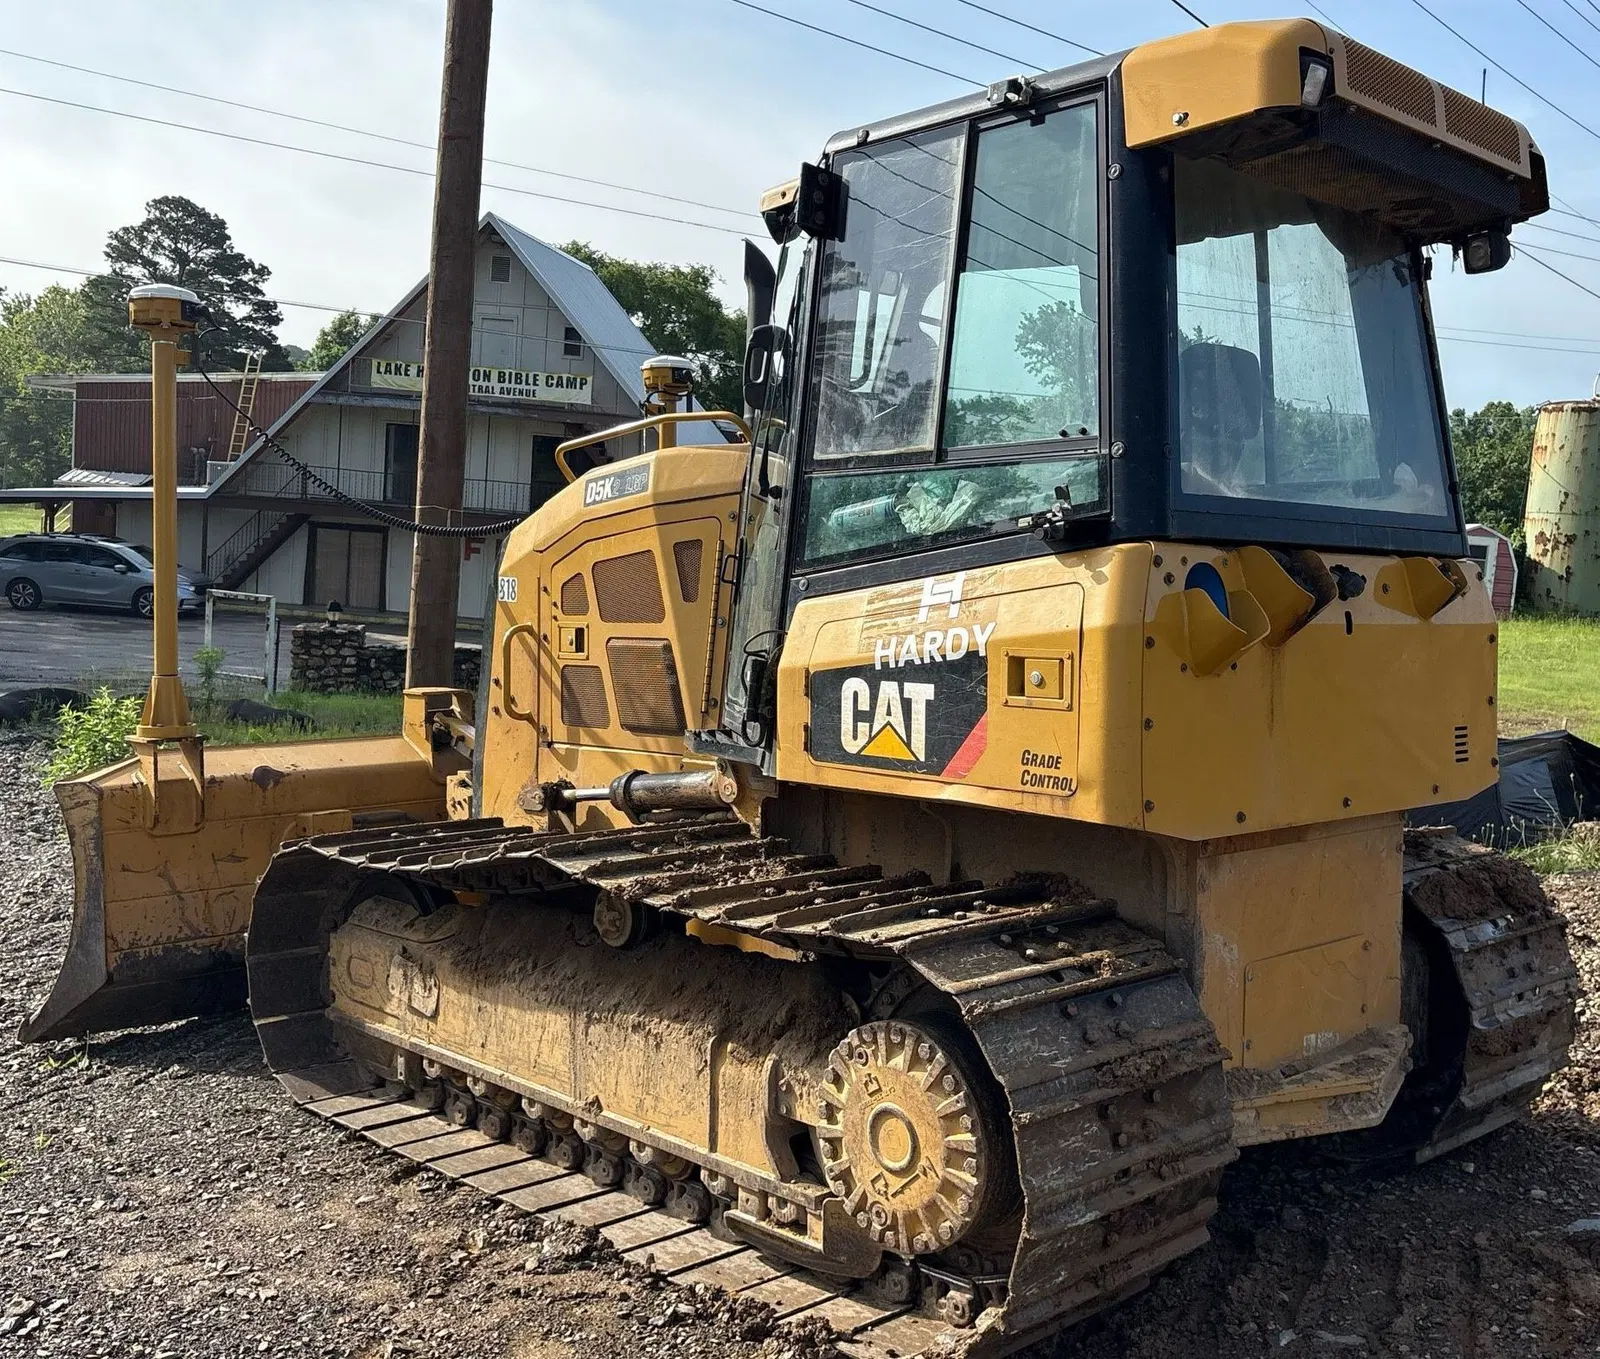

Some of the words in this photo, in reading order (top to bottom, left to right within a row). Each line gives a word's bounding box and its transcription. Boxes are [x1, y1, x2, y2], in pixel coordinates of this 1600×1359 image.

[376, 361, 411, 377] LAKE
[497, 370, 540, 387] BIBLE
[545, 374, 588, 391] CAMP
[469, 384, 495, 395] TRAL
[499, 387, 537, 398] AVENUE
[499, 578, 517, 601] 818
[874, 621, 997, 670] HARDY
[841, 677, 935, 762] CAT
[1021, 749, 1062, 770] GRADE
[1021, 769, 1073, 792] CONTROL
